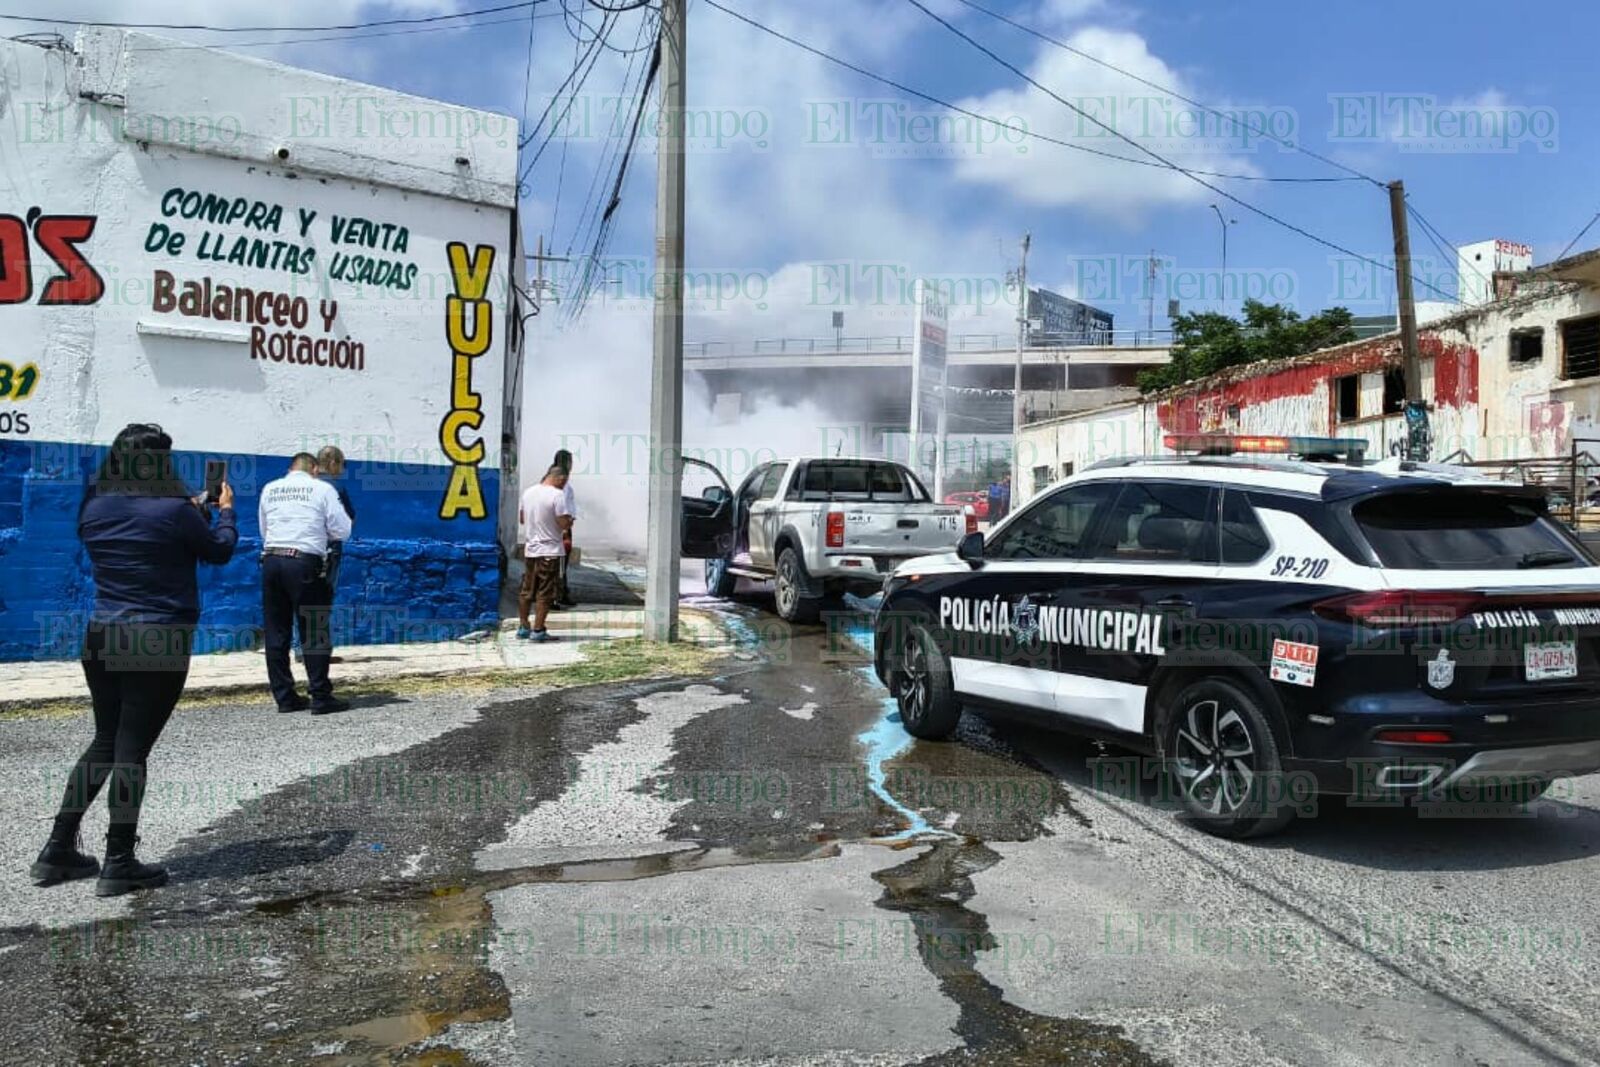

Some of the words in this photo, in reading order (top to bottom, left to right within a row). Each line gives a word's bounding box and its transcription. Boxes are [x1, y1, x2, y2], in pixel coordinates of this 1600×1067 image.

[161, 187, 283, 233] COMPRA
[299, 208, 317, 238] Y
[331, 214, 410, 254] VENTA
[144, 222, 186, 256] De
[196, 231, 317, 276] LLANTAS
[329, 251, 419, 290] USADAS
[152, 269, 309, 330] Balanceo
[439, 241, 496, 519] VULCA
[1270, 555, 1329, 579] SP-210
[940, 594, 1011, 637] POLICÍA
[1038, 605, 1165, 656] MUNICIPAL
[1472, 607, 1540, 629] POLICÍA
[1275, 642, 1314, 663] 911
